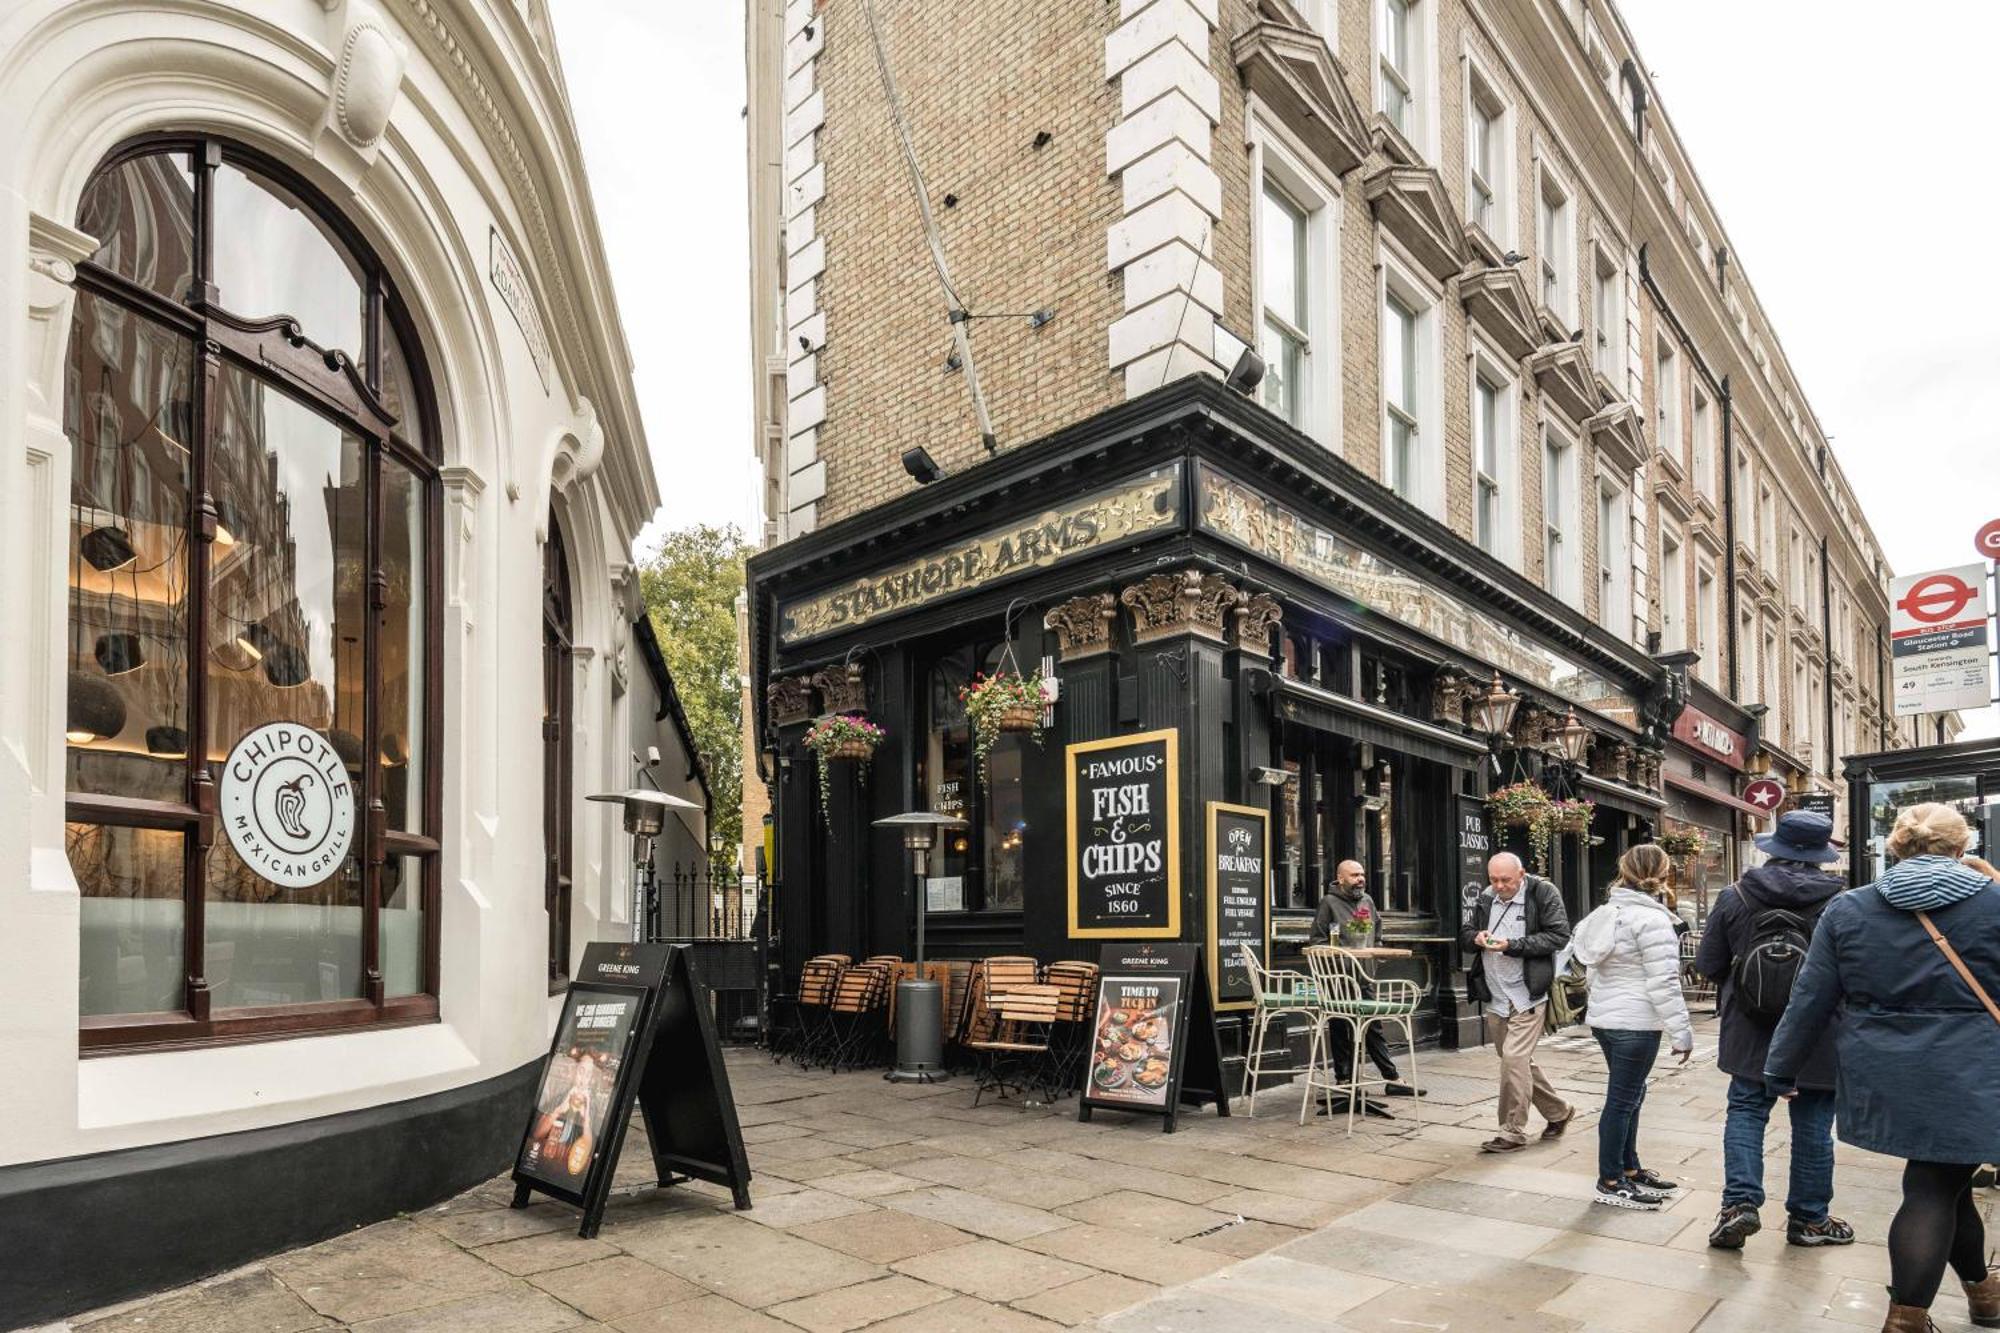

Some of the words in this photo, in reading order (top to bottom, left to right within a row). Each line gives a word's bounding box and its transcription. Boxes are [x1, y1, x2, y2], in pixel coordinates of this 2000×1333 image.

[830, 545, 984, 622] STANHOPE
[995, 509, 1098, 575] ARMS
[1903, 634, 1950, 646] Gloucester
[1952, 630, 1975, 639] Road
[1917, 642, 1948, 651] Station
[1903, 664, 1929, 673] South
[1930, 658, 1978, 669] Kensington
[1902, 681, 1916, 689] 49
[232, 729, 349, 801] CHIPOTLE
[1089, 755, 1156, 779] FAMOUS
[937, 782, 960, 794] FISH
[934, 799, 964, 811] CHIPS
[1092, 783, 1150, 821] FISH
[1110, 816, 1126, 843] &
[1465, 815, 1481, 833] PUB
[1228, 830, 1252, 846] OPEN
[1459, 831, 1489, 851] CLASSICS
[235, 815, 307, 878] MEXICAN
[311, 829, 348, 875] GRILL
[1082, 839, 1162, 879] CHIPS
[1218, 854, 1262, 874] BREAKFAST
[1104, 882, 1141, 898] SINCE
[1108, 900, 1139, 913] 1860
[598, 963, 622, 973] GREENE
[622, 964, 640, 974] KING
[1121, 957, 1149, 965] GREENE
[1150, 957, 1169, 965] KING
[1120, 986, 1145, 997] TIME
[1146, 986, 1159, 997] TO
[1120, 997, 1145, 1010] TUCK
[1146, 998, 1158, 1009] IN
